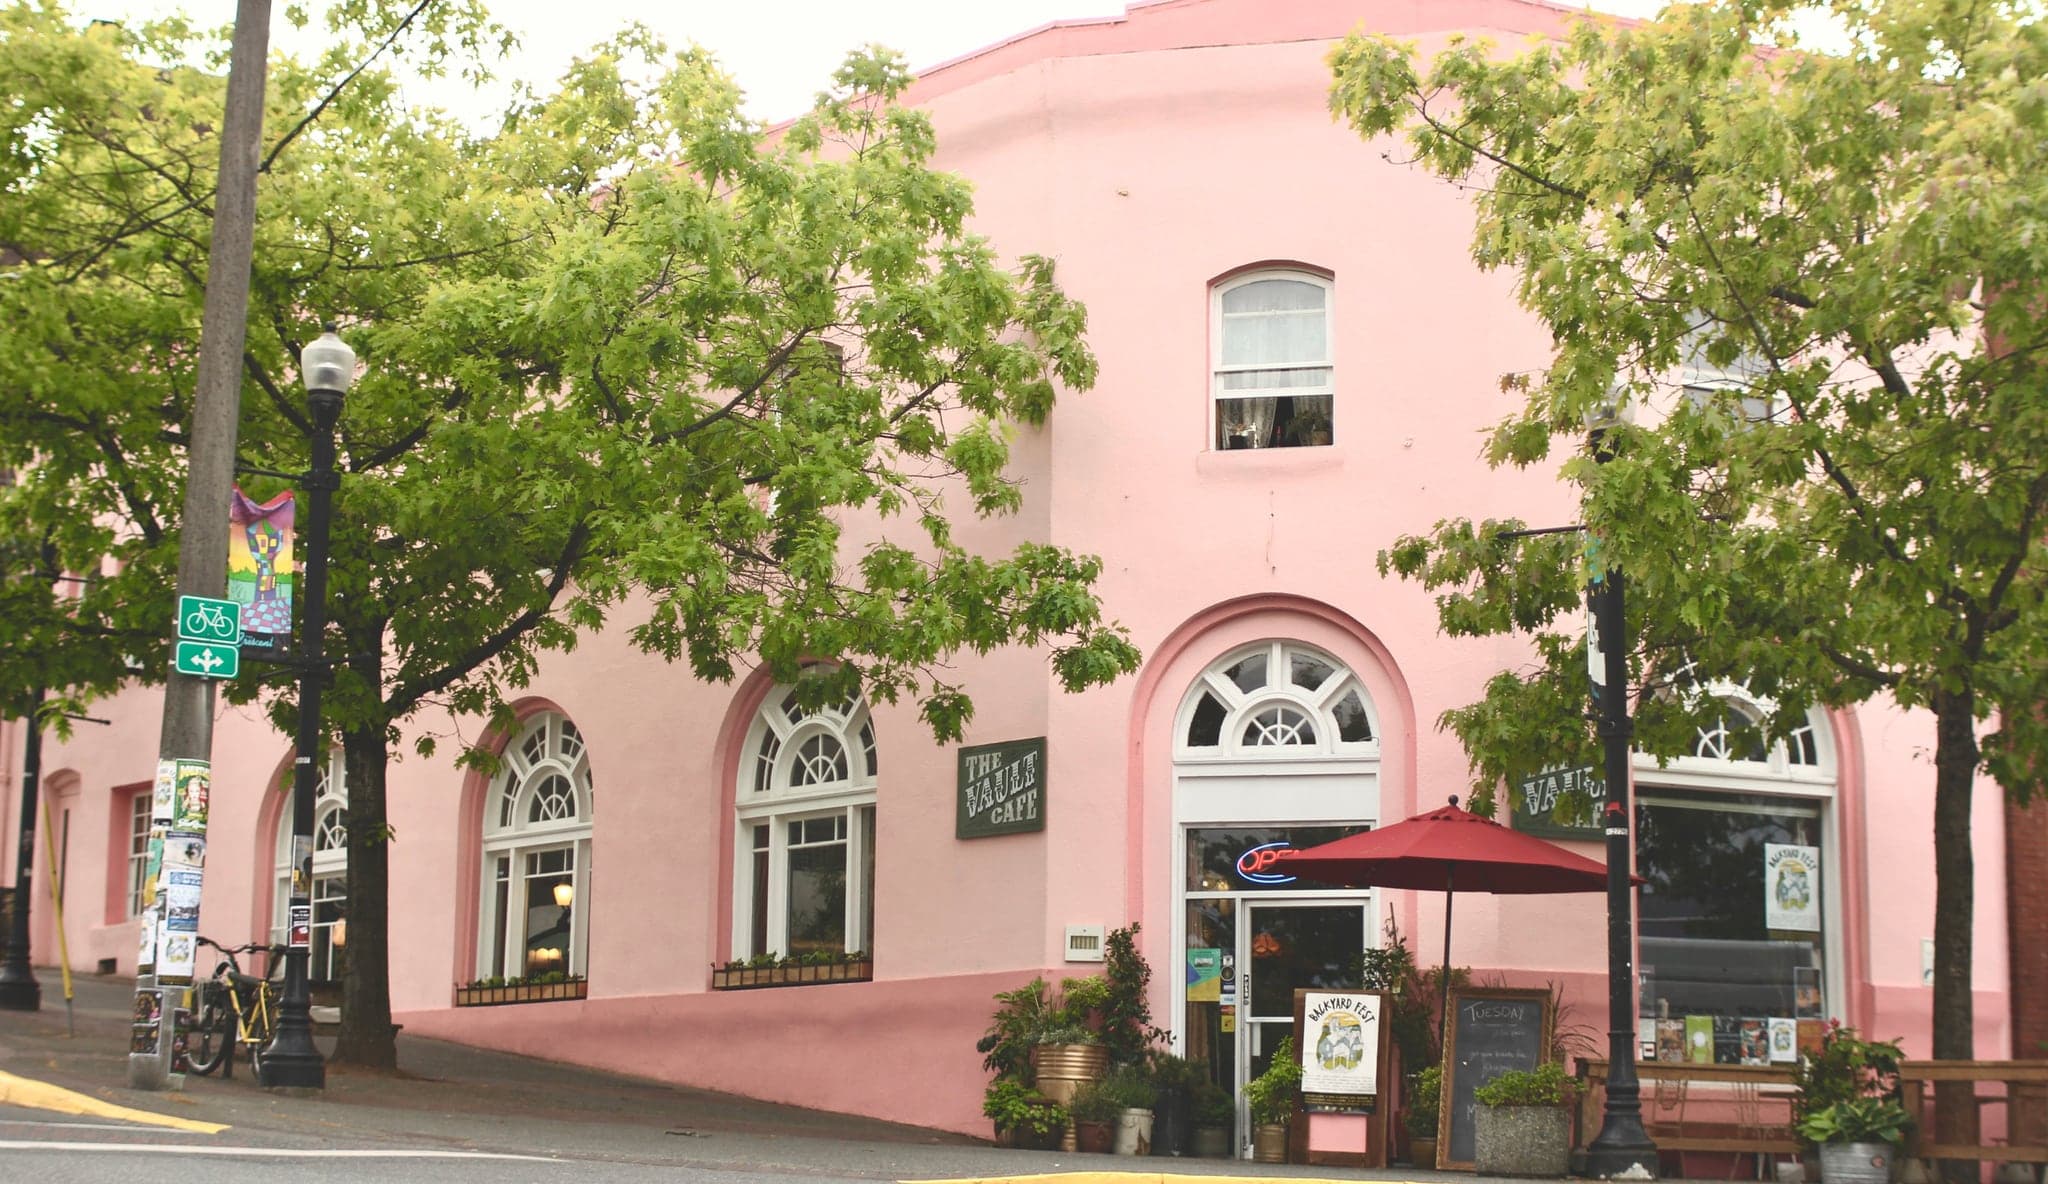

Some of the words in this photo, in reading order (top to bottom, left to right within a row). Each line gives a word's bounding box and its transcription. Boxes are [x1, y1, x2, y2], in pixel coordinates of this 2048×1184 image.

[965, 751, 1002, 783] THE
[965, 751, 1038, 818] VAULT
[991, 788, 1038, 824] CAFE
[1308, 998, 1352, 1022] BACKYARD
[1354, 1002, 1376, 1023] FEST
